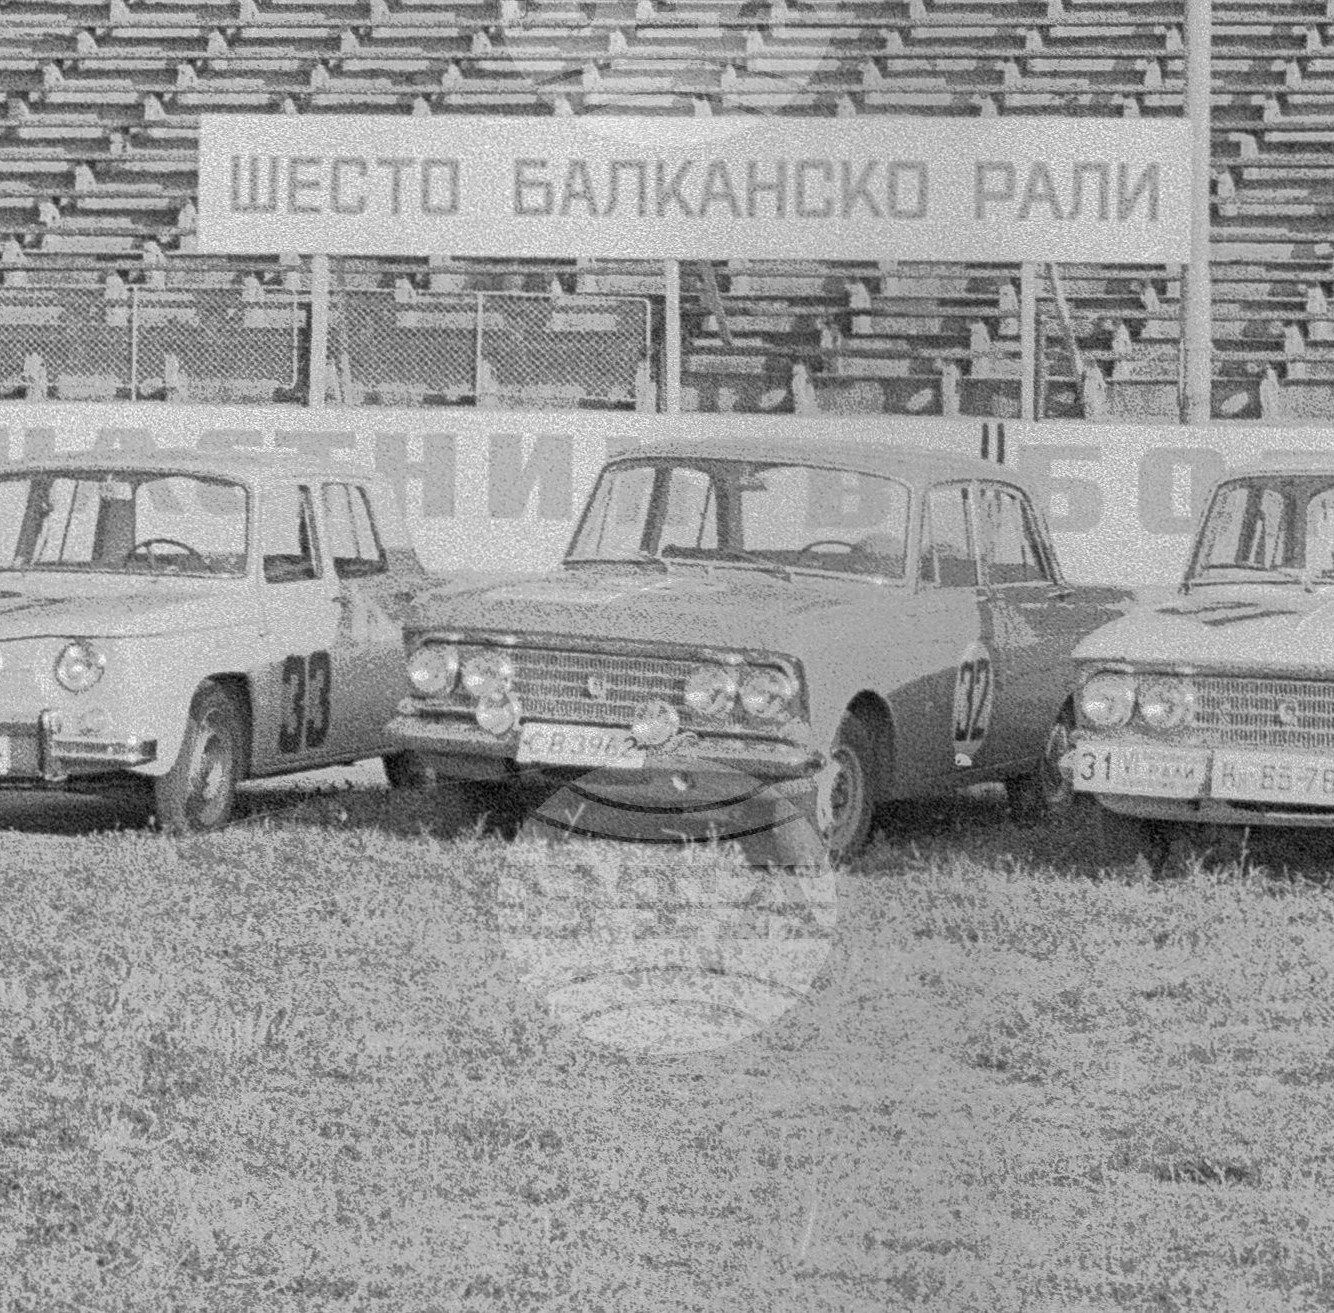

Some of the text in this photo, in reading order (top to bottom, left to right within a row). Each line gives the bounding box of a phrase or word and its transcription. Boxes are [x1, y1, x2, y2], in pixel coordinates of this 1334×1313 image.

[230, 155, 1162, 223] ШЕСТО БАЛКАНСКО РАЛИ
[278, 649, 332, 755] 33
[954, 658, 990, 742] 32
[1080, 752, 1112, 781] 31
